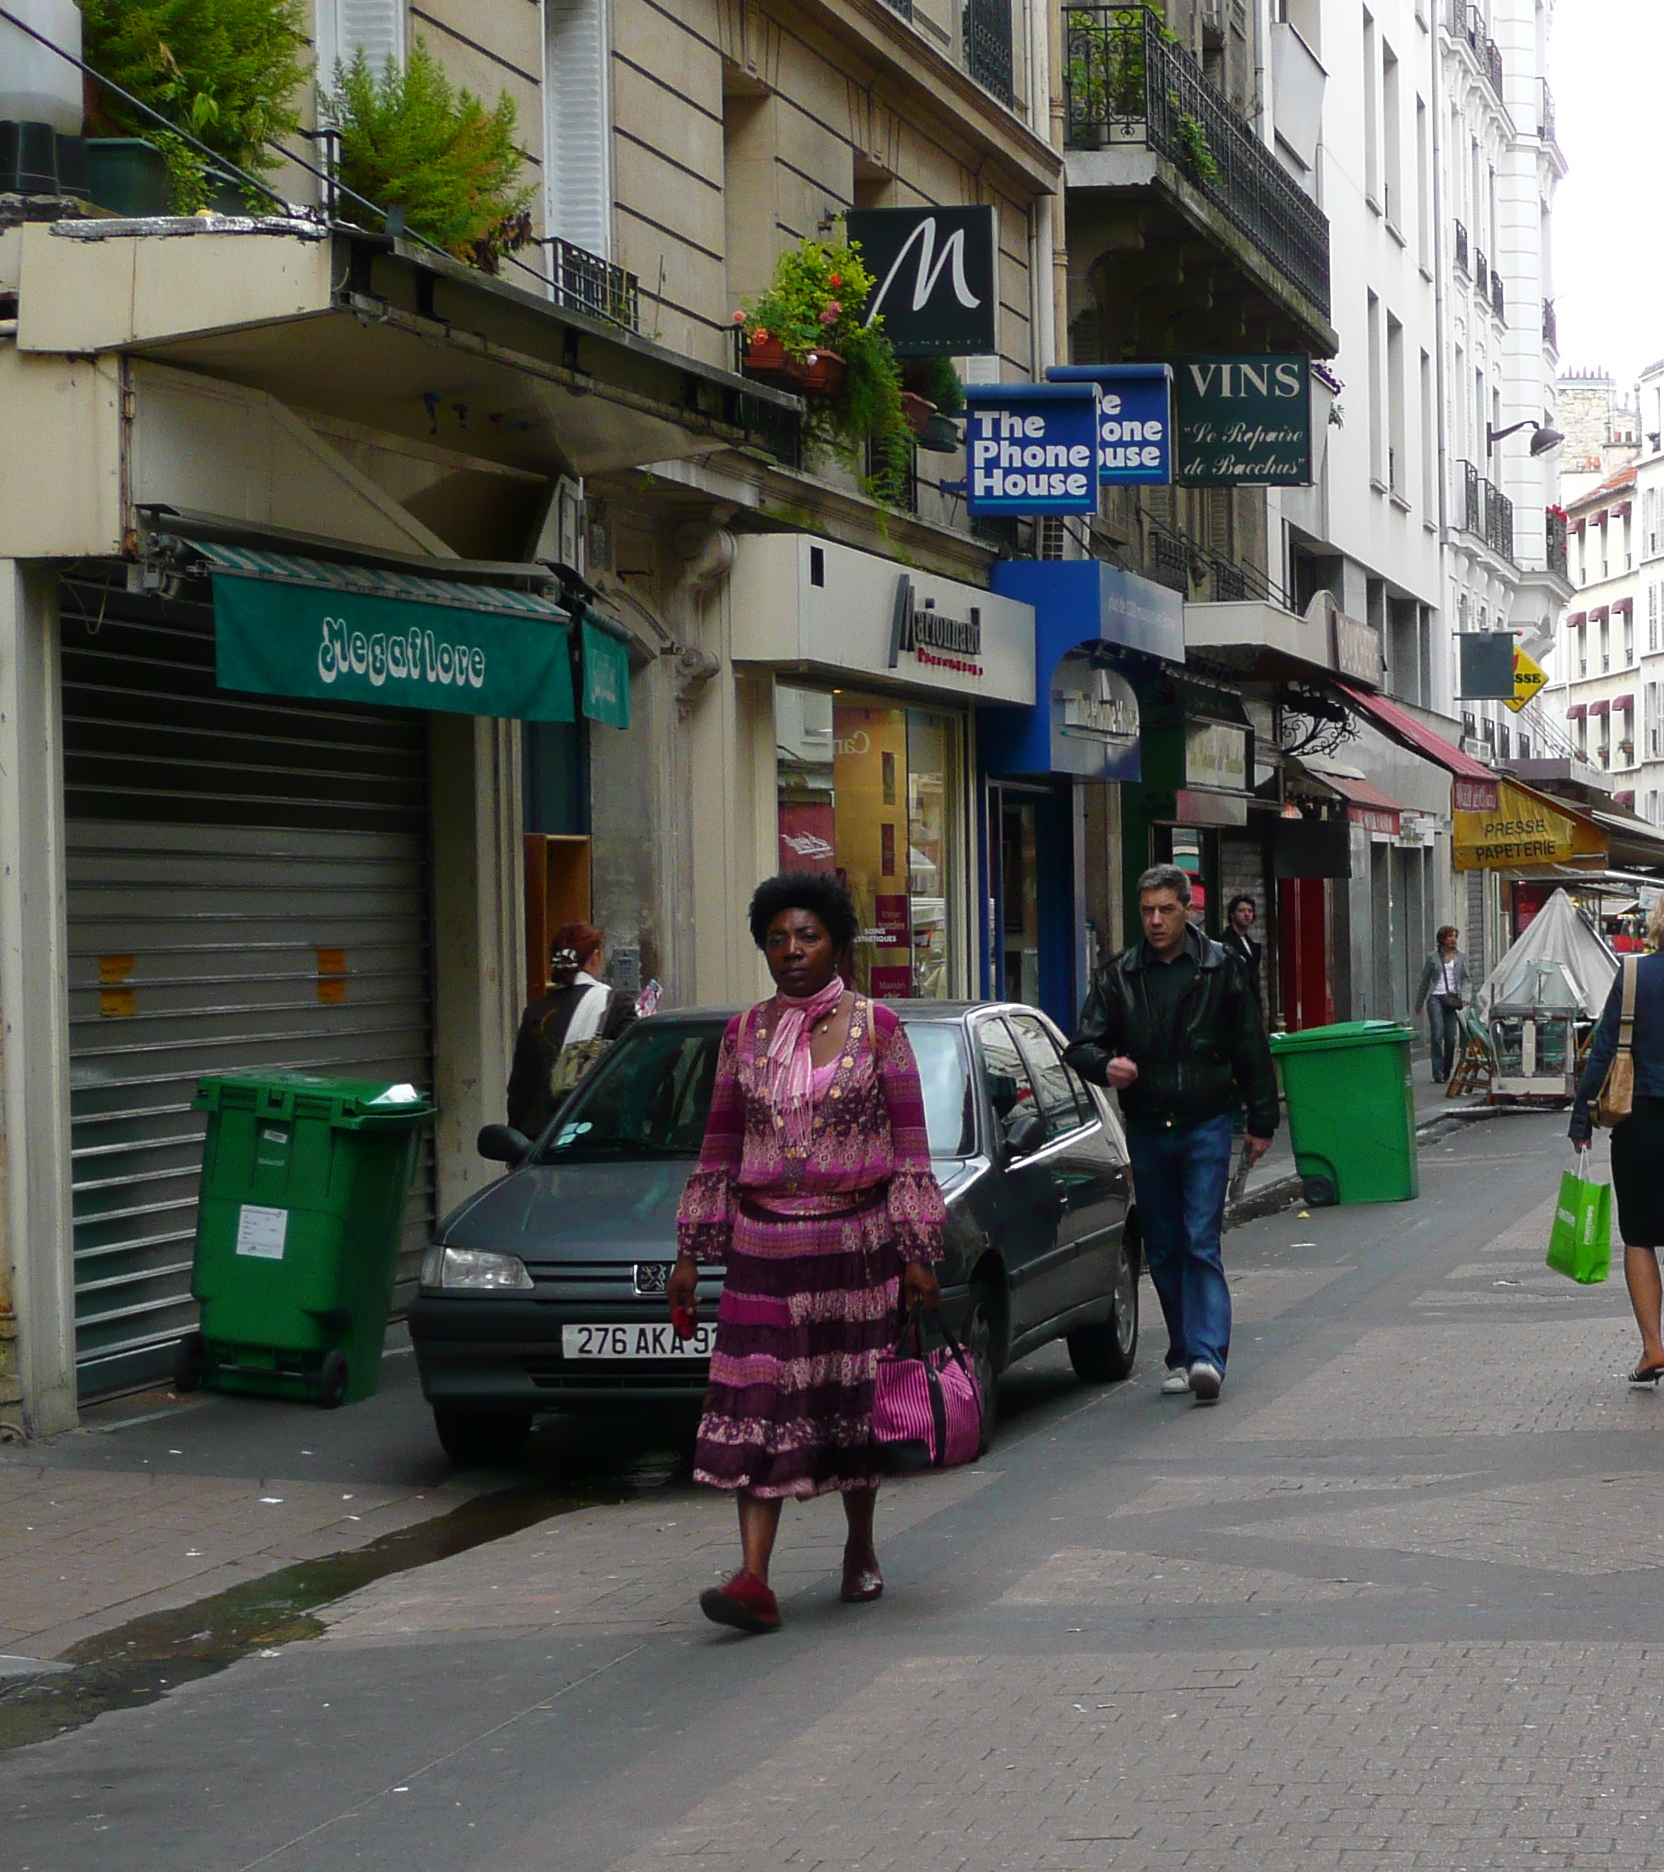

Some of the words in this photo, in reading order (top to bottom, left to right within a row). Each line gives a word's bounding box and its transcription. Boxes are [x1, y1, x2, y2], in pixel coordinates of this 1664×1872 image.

[866, 216, 982, 328] M
[1187, 363, 1300, 398] VINS
[974, 410, 1046, 438] The
[1097, 420, 1163, 442] one
[1222, 422, 1303, 451] Repaire
[973, 440, 1092, 468] Phone
[1098, 446, 1160, 467] use
[1184, 457, 1206, 475] de
[974, 469, 1087, 496] House
[319, 617, 485, 688] Megaflore
[1513, 672, 1542, 684] SSE
[1484, 819, 1545, 838] PRESSE
[1475, 841, 1556, 860] PAPETERIE
[578, 1327, 627, 1354] 276
[635, 1327, 685, 1354] AKA
